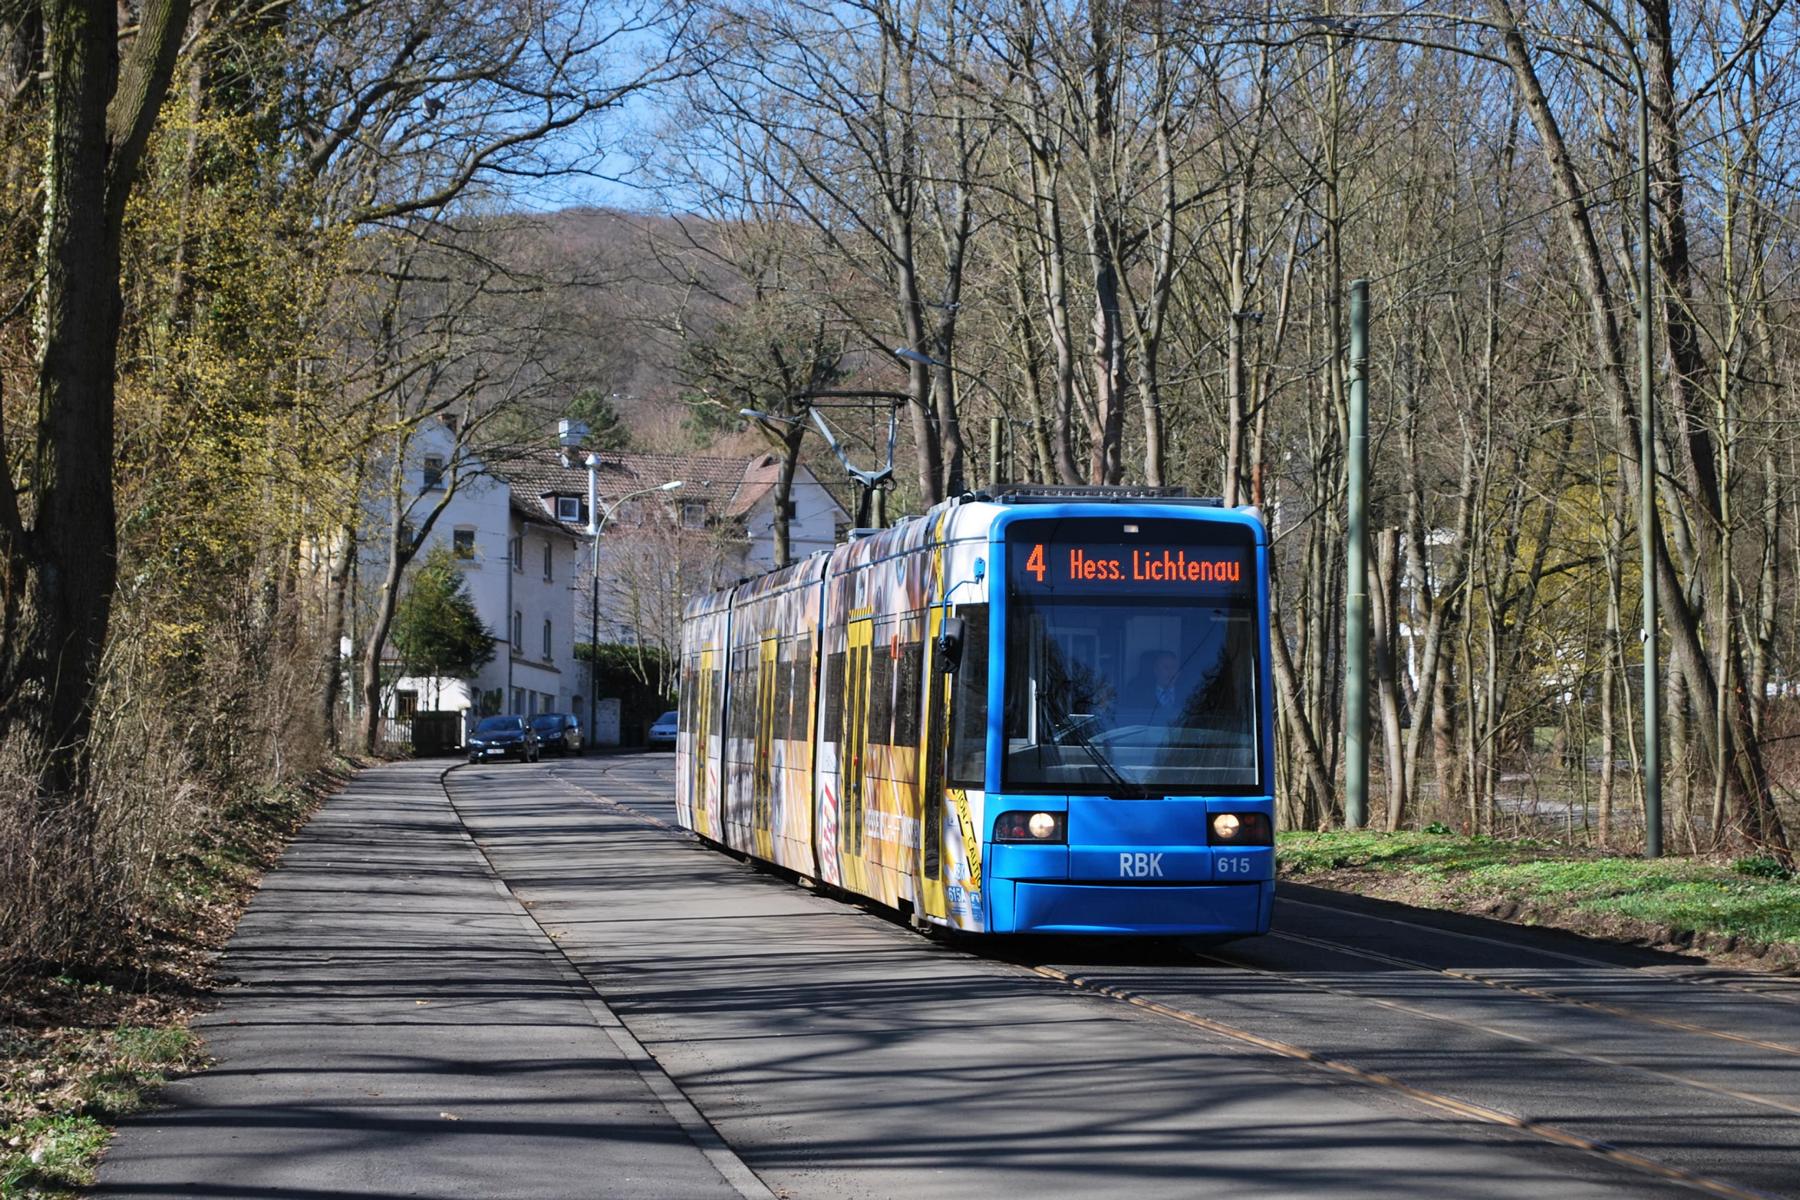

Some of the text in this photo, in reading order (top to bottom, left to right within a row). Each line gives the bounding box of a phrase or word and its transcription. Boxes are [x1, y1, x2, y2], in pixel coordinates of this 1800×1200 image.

[1026, 543, 1240, 582] 4 Hess. Lichtenau
[1119, 852, 1164, 878] RBK
[1217, 857, 1251, 873] 615
